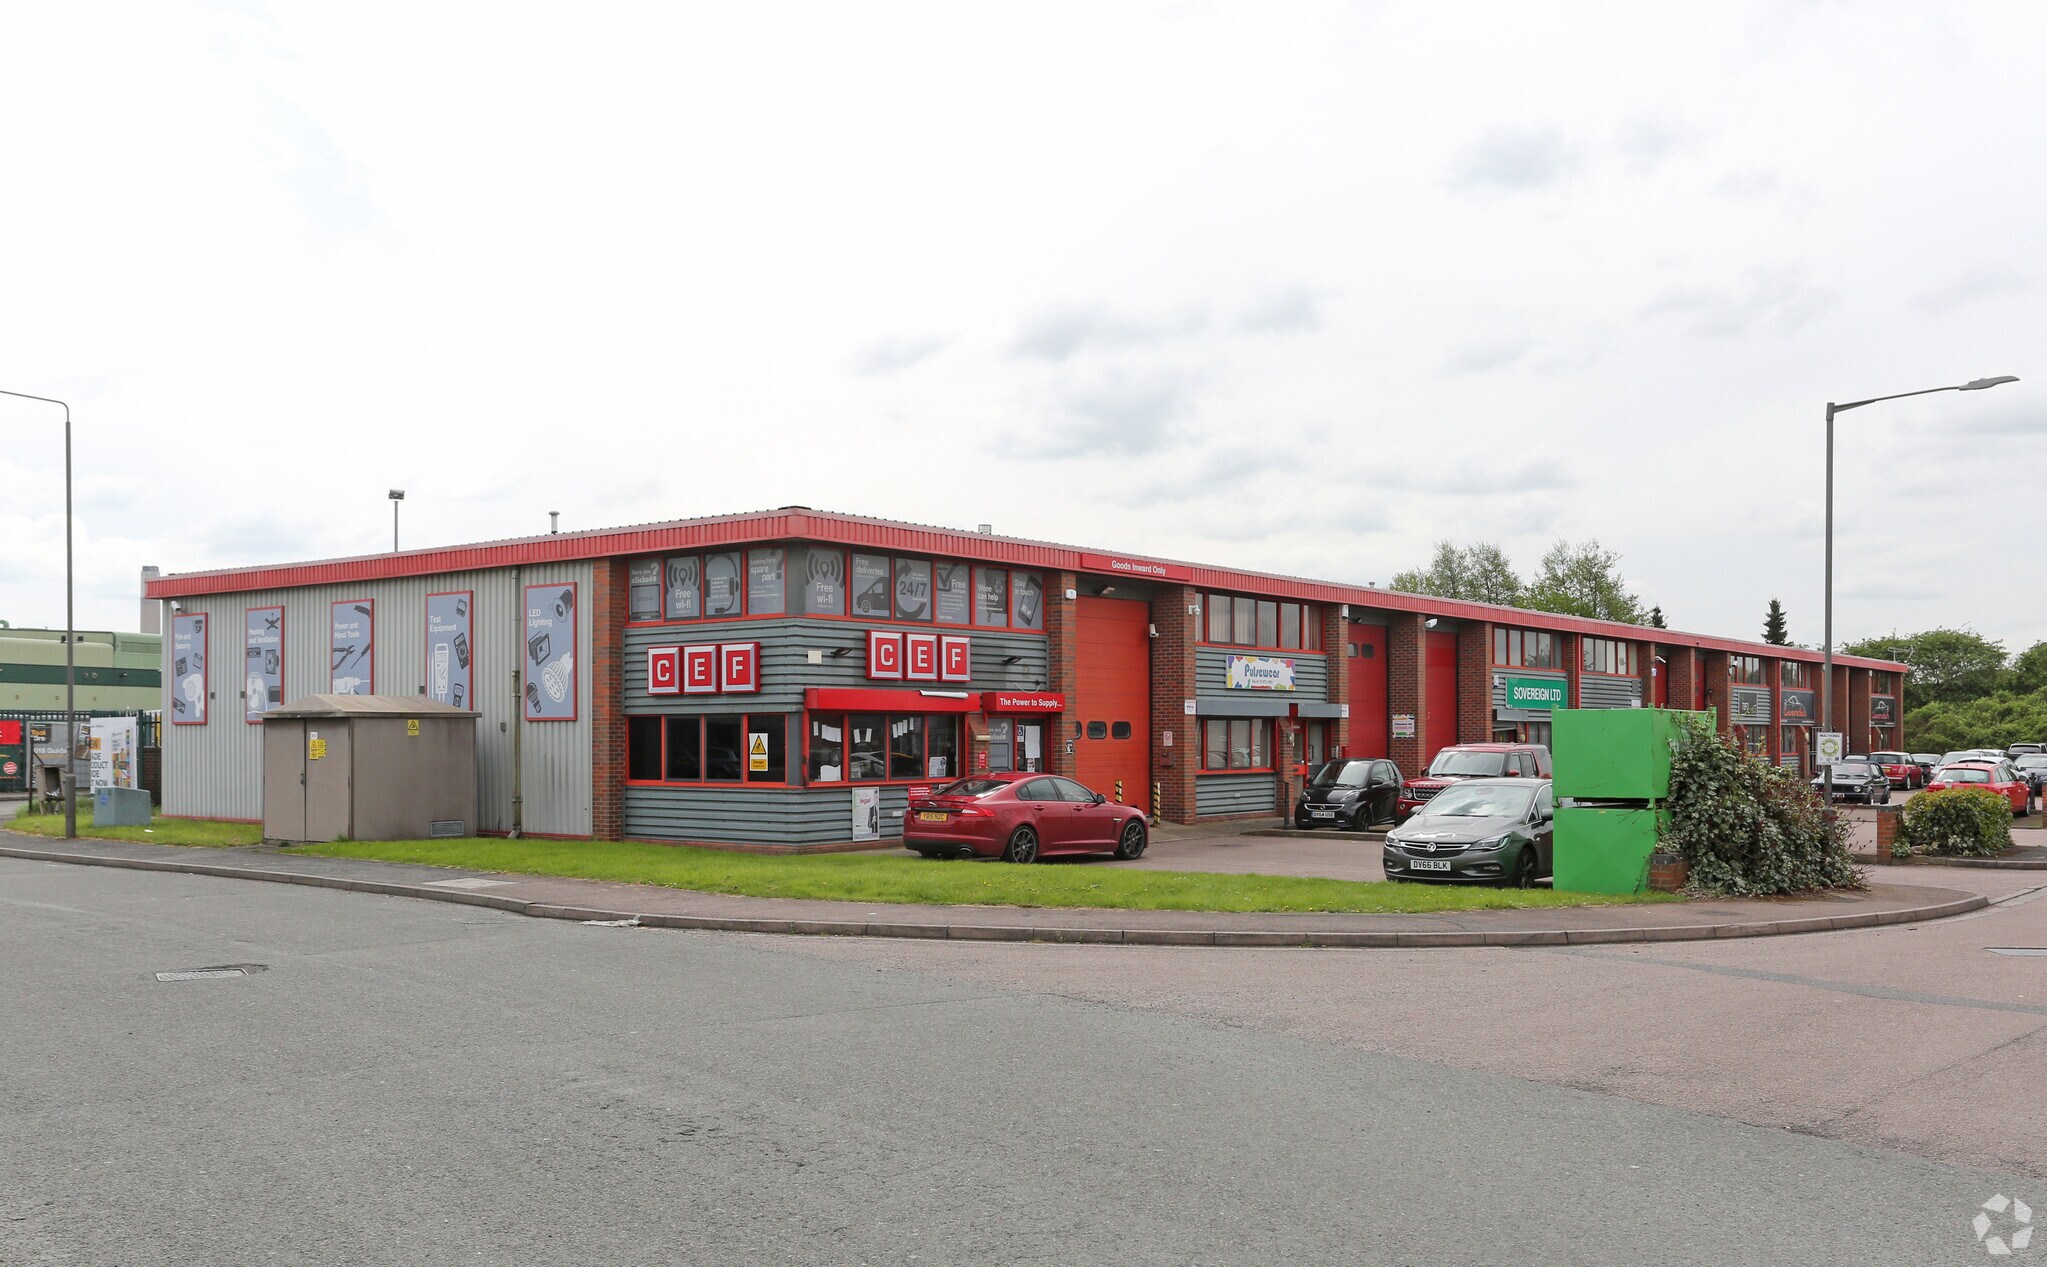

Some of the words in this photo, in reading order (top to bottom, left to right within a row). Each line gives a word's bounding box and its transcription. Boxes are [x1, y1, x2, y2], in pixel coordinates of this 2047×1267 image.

[856, 558, 869, 566] Free
[750, 566, 768, 575] spare
[856, 566, 884, 576] deliveries
[1111, 560, 1131, 571] Goods
[1132, 563, 1152, 573] Inward
[1152, 565, 1166, 576] Only
[762, 574, 776, 583] part
[1014, 579, 1026, 588] Stay
[816, 582, 833, 592] Free
[900, 580, 928, 598] 24/7
[952, 579, 966, 589] Free
[676, 589, 691, 598] Free
[1020, 588, 1034, 596] touch
[816, 594, 833, 604] wi-fi
[988, 593, 998, 602] help
[676, 599, 691, 609] wi-fi
[529, 608, 541, 617] LED
[335, 622, 349, 630] Power
[529, 618, 552, 628] Lighting
[248, 628, 264, 636] Heating
[430, 624, 457, 633] Equipment
[335, 631, 347, 639] Hand
[347, 630, 360, 638] Tools
[257, 636, 279, 644] Ventilation
[881, 644, 961, 669] CEF
[656, 656, 743, 681] CEF
[1244, 663, 1280, 678] Pulsewear
[1514, 686, 1550, 700] SOVEREIGN
[1550, 689, 1561, 701] LTD
[1012, 698, 1030, 706] Power
[1038, 698, 1062, 708] Supply...
[1413, 860, 1432, 869] DY66
[1433, 861, 1448, 870] BLK
